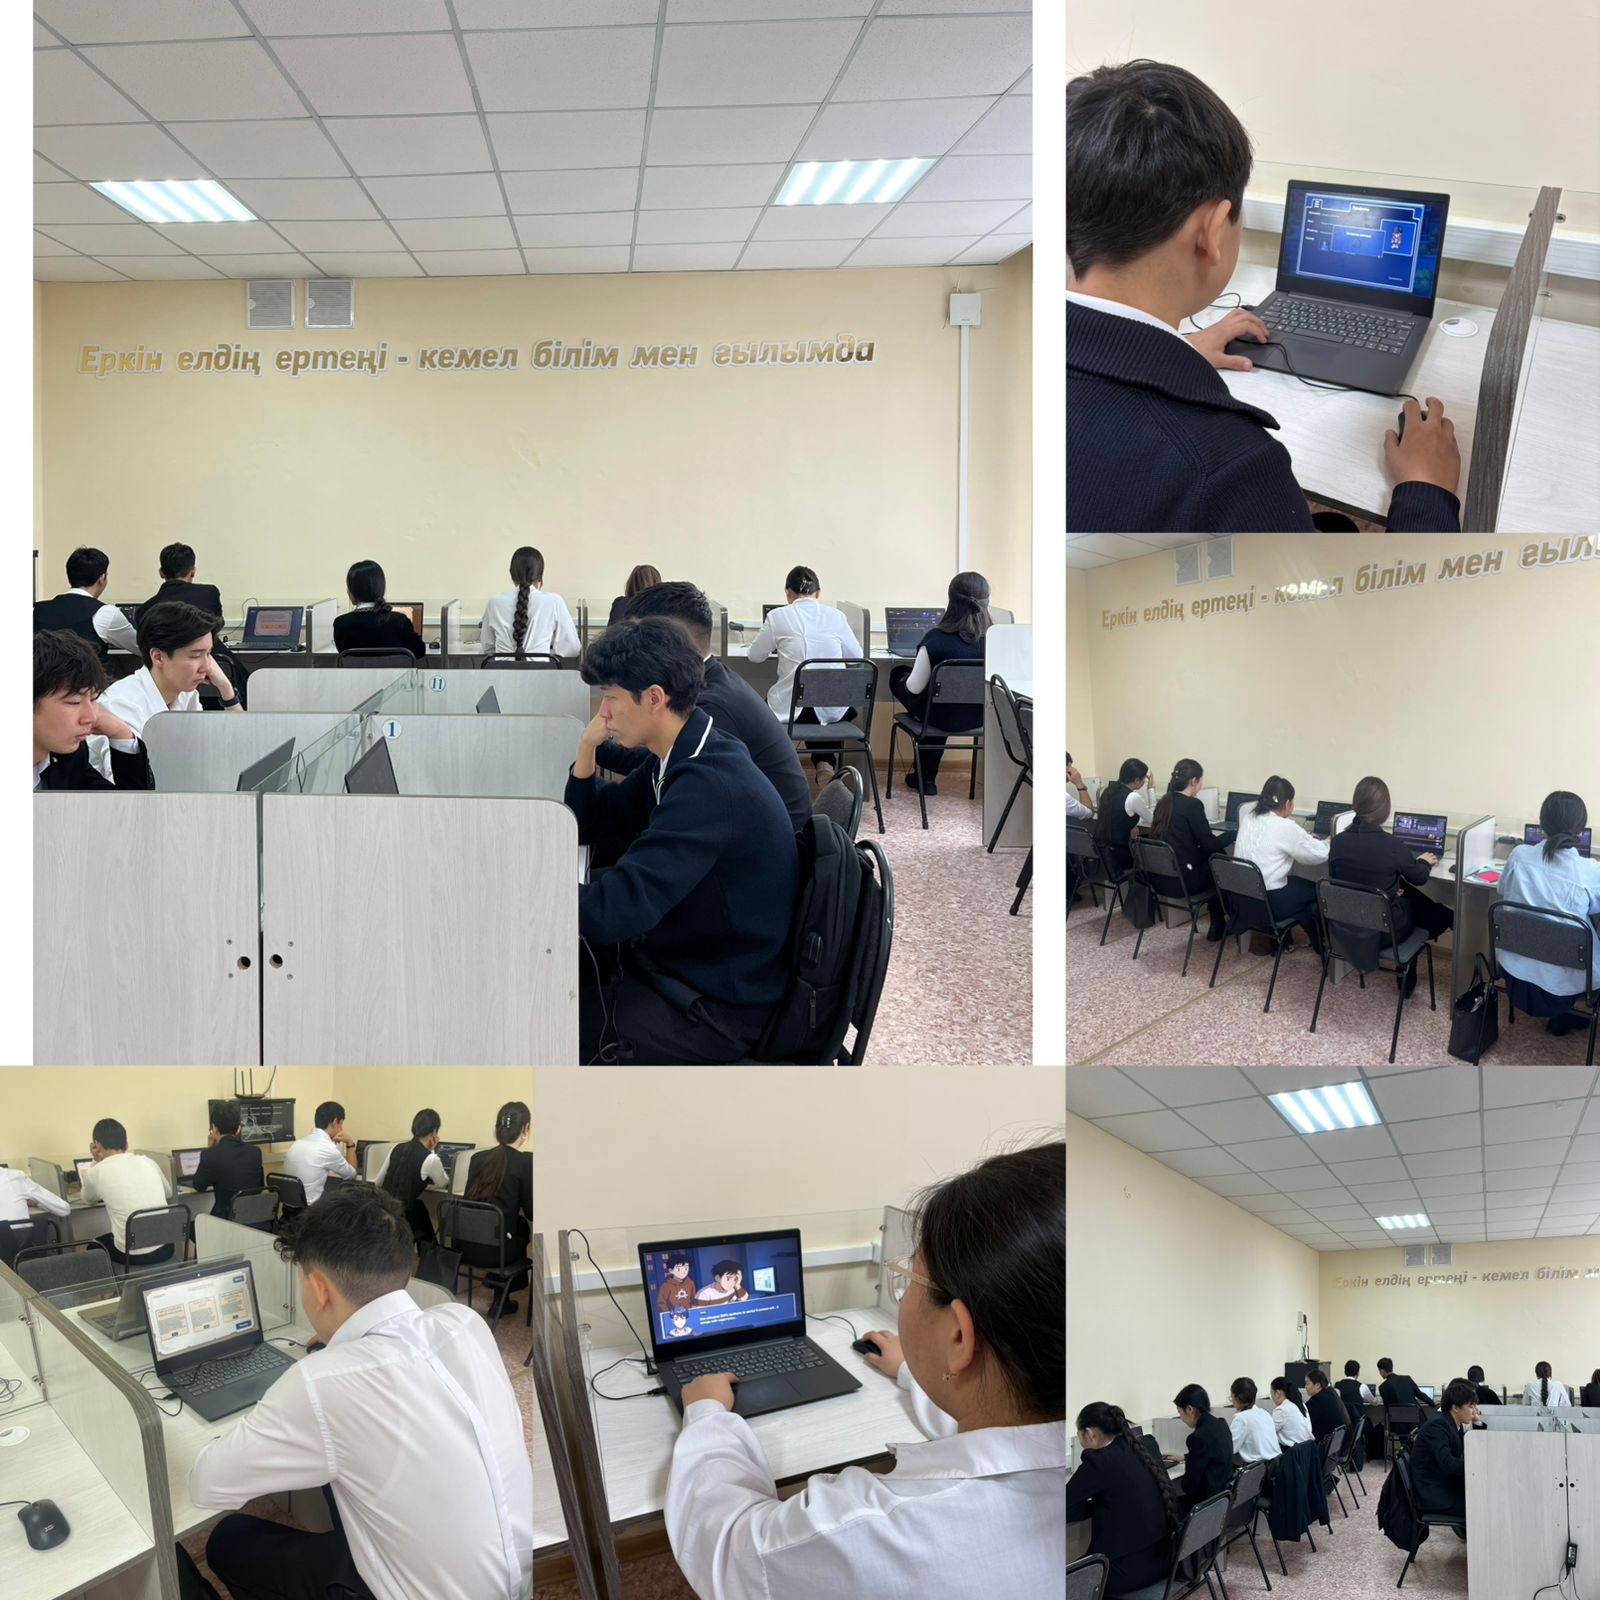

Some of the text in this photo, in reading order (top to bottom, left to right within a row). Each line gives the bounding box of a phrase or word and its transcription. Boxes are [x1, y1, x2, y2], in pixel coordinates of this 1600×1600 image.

[79, 344, 163, 377] Еркін
[177, 342, 262, 376] елдің
[275, 341, 388, 377] ертеңі
[418, 345, 519, 370] кемел
[532, 337, 619, 369] білім
[630, 342, 698, 367] мен
[1101, 606, 1137, 630] Еркін
[1143, 599, 1185, 622] елдің
[1191, 585, 1255, 619] ертеңі
[1354, 558, 1427, 593] білім
[1437, 550, 1503, 580] мен
[388, 721, 395, 737] 1
[1481, 1270, 1530, 1282] кемел
